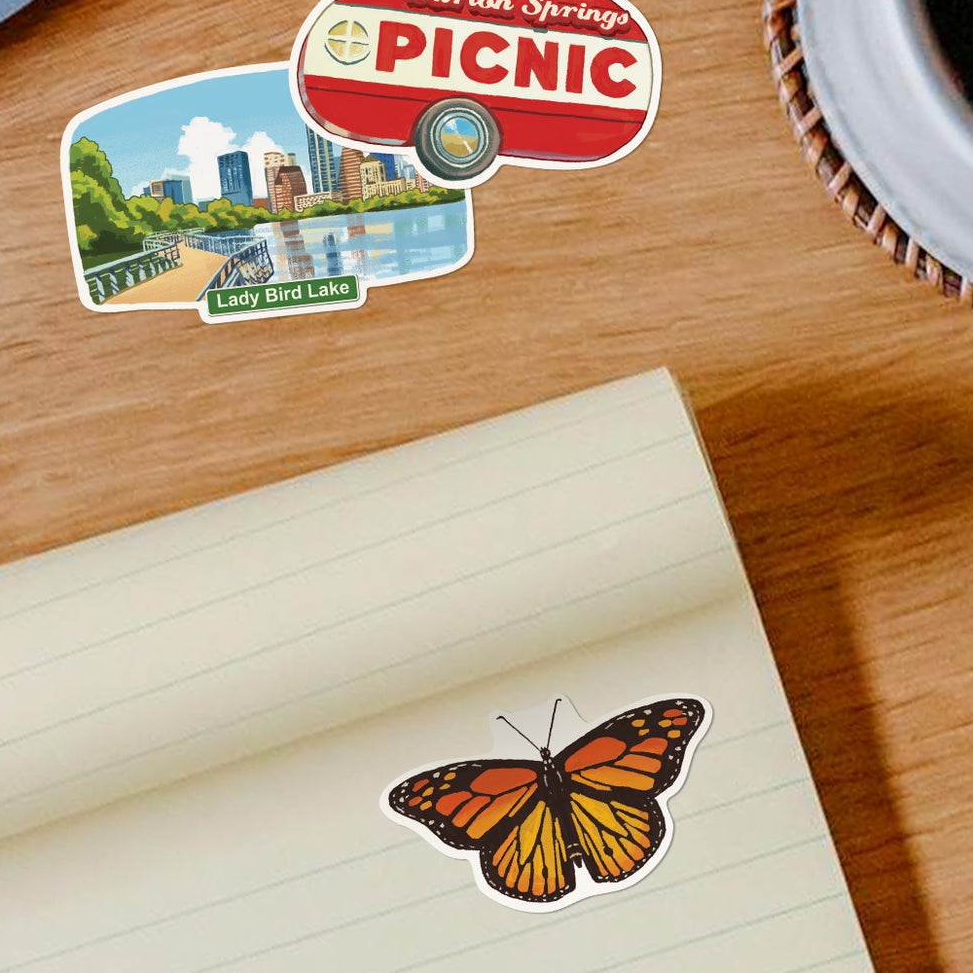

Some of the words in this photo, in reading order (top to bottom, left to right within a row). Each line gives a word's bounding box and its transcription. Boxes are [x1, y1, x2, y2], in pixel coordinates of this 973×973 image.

[375, 20, 638, 98] PICNIC
[217, 289, 259, 308] Lady
[265, 284, 303, 303] Bird
[307, 280, 350, 298] Lake
